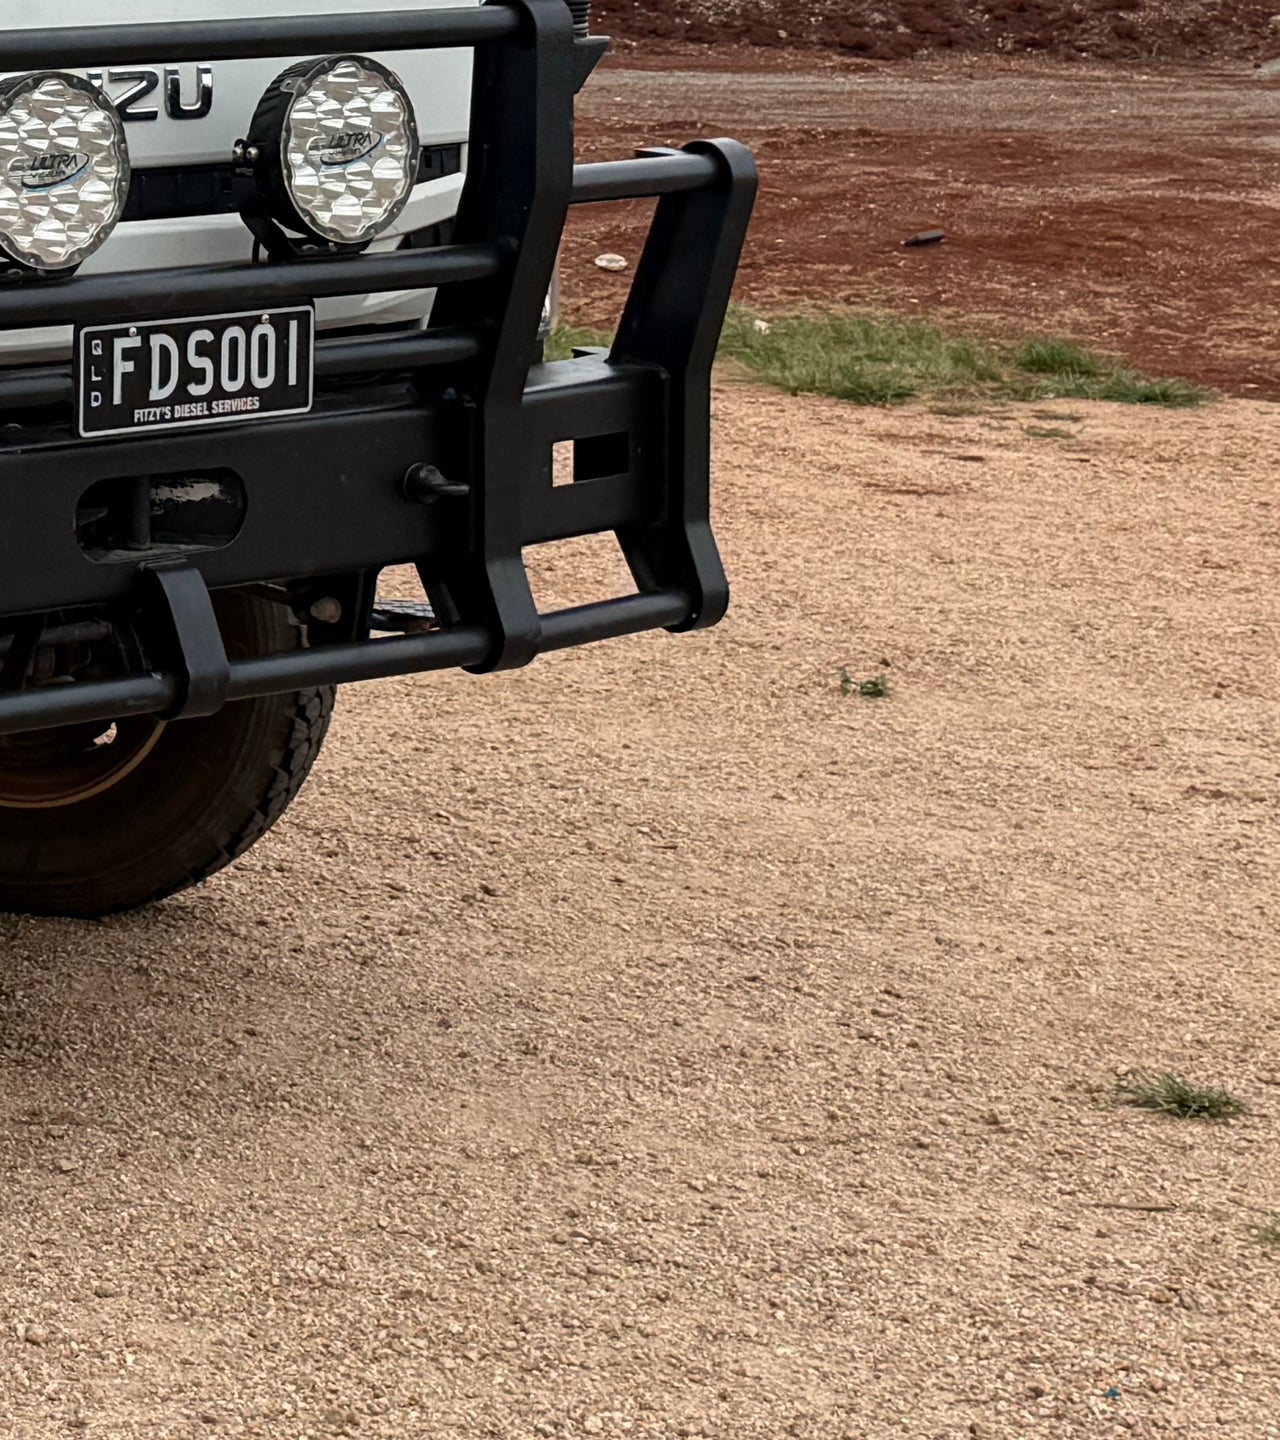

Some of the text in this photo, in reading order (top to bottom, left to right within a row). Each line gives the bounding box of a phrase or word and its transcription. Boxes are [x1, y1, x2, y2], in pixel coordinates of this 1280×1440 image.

[112, 319, 298, 406] FDS001
[133, 396, 261, 424] FITZY'S DIESEL SERVICES
